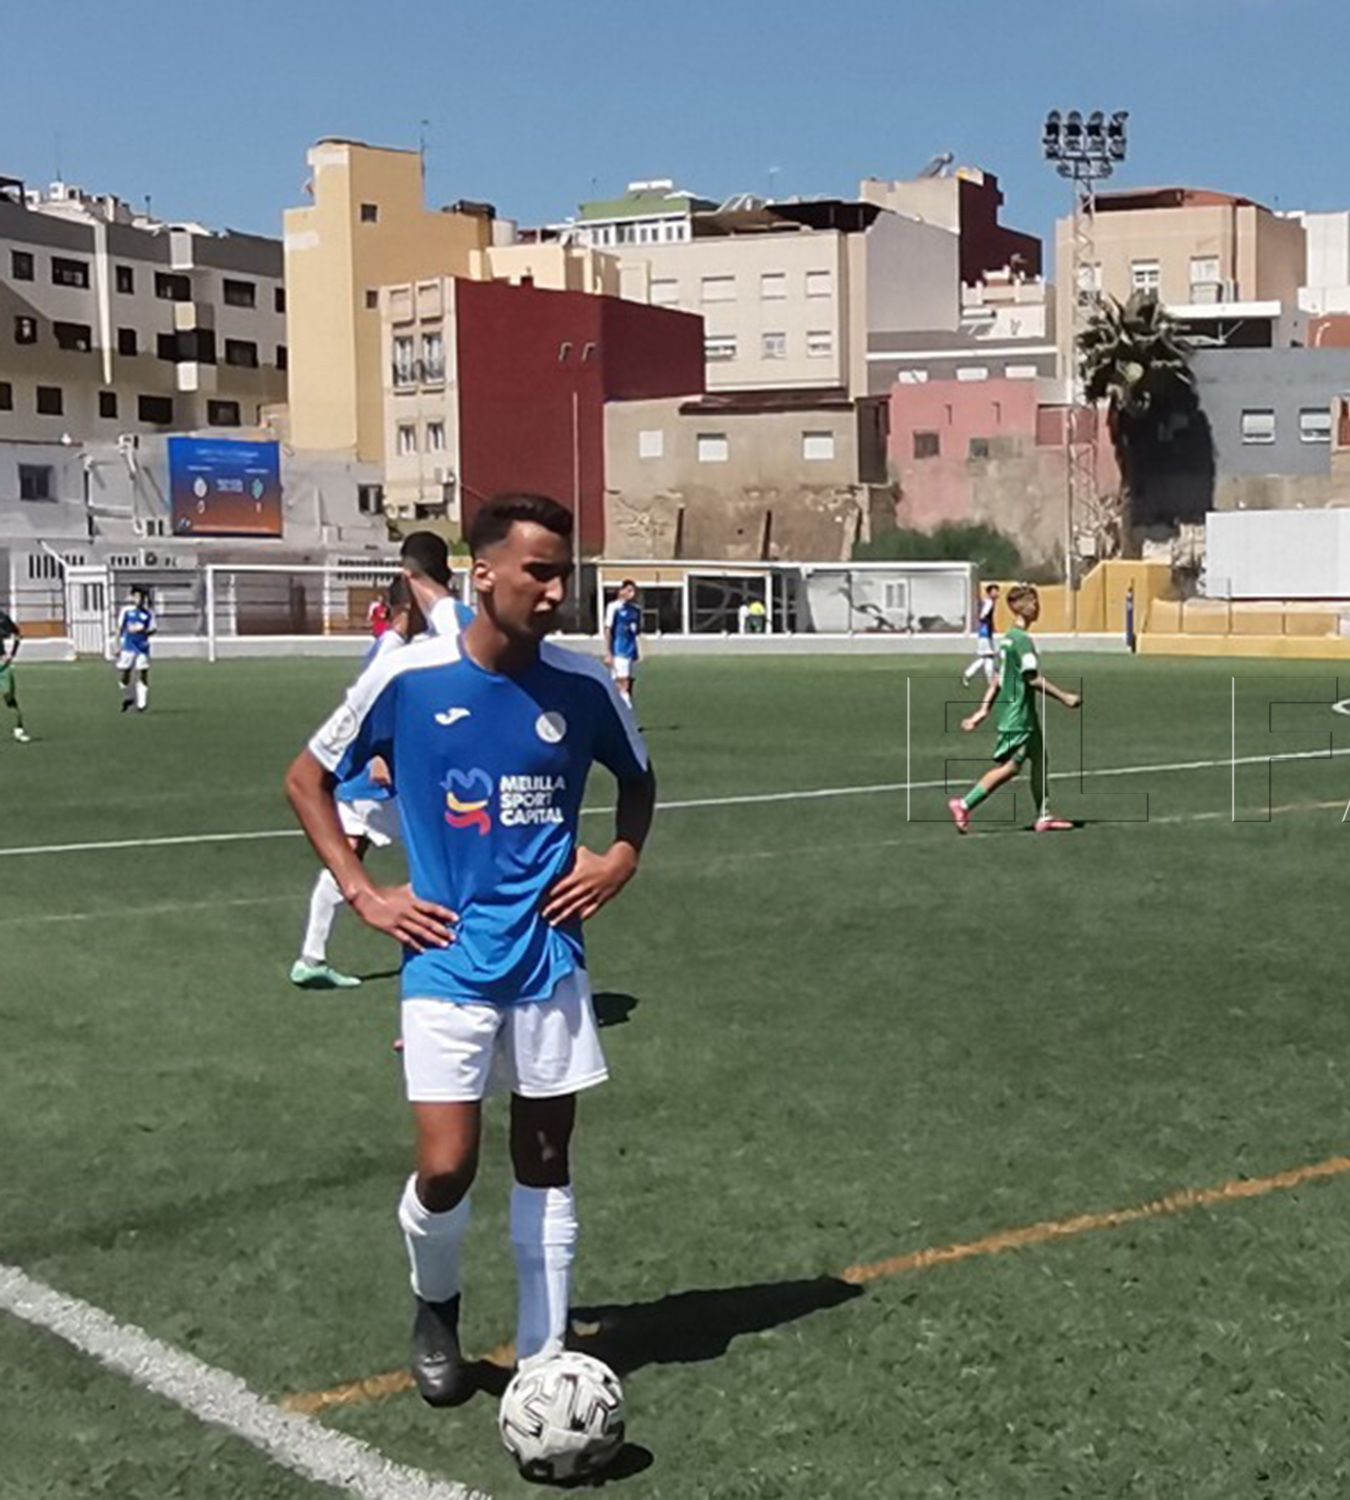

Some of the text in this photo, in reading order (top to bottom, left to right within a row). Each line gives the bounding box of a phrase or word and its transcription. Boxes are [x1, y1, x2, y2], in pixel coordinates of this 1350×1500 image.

[500, 775, 566, 792] MELILLA
[500, 791, 552, 809] SPORT
[500, 807, 564, 827] CAPITAL
